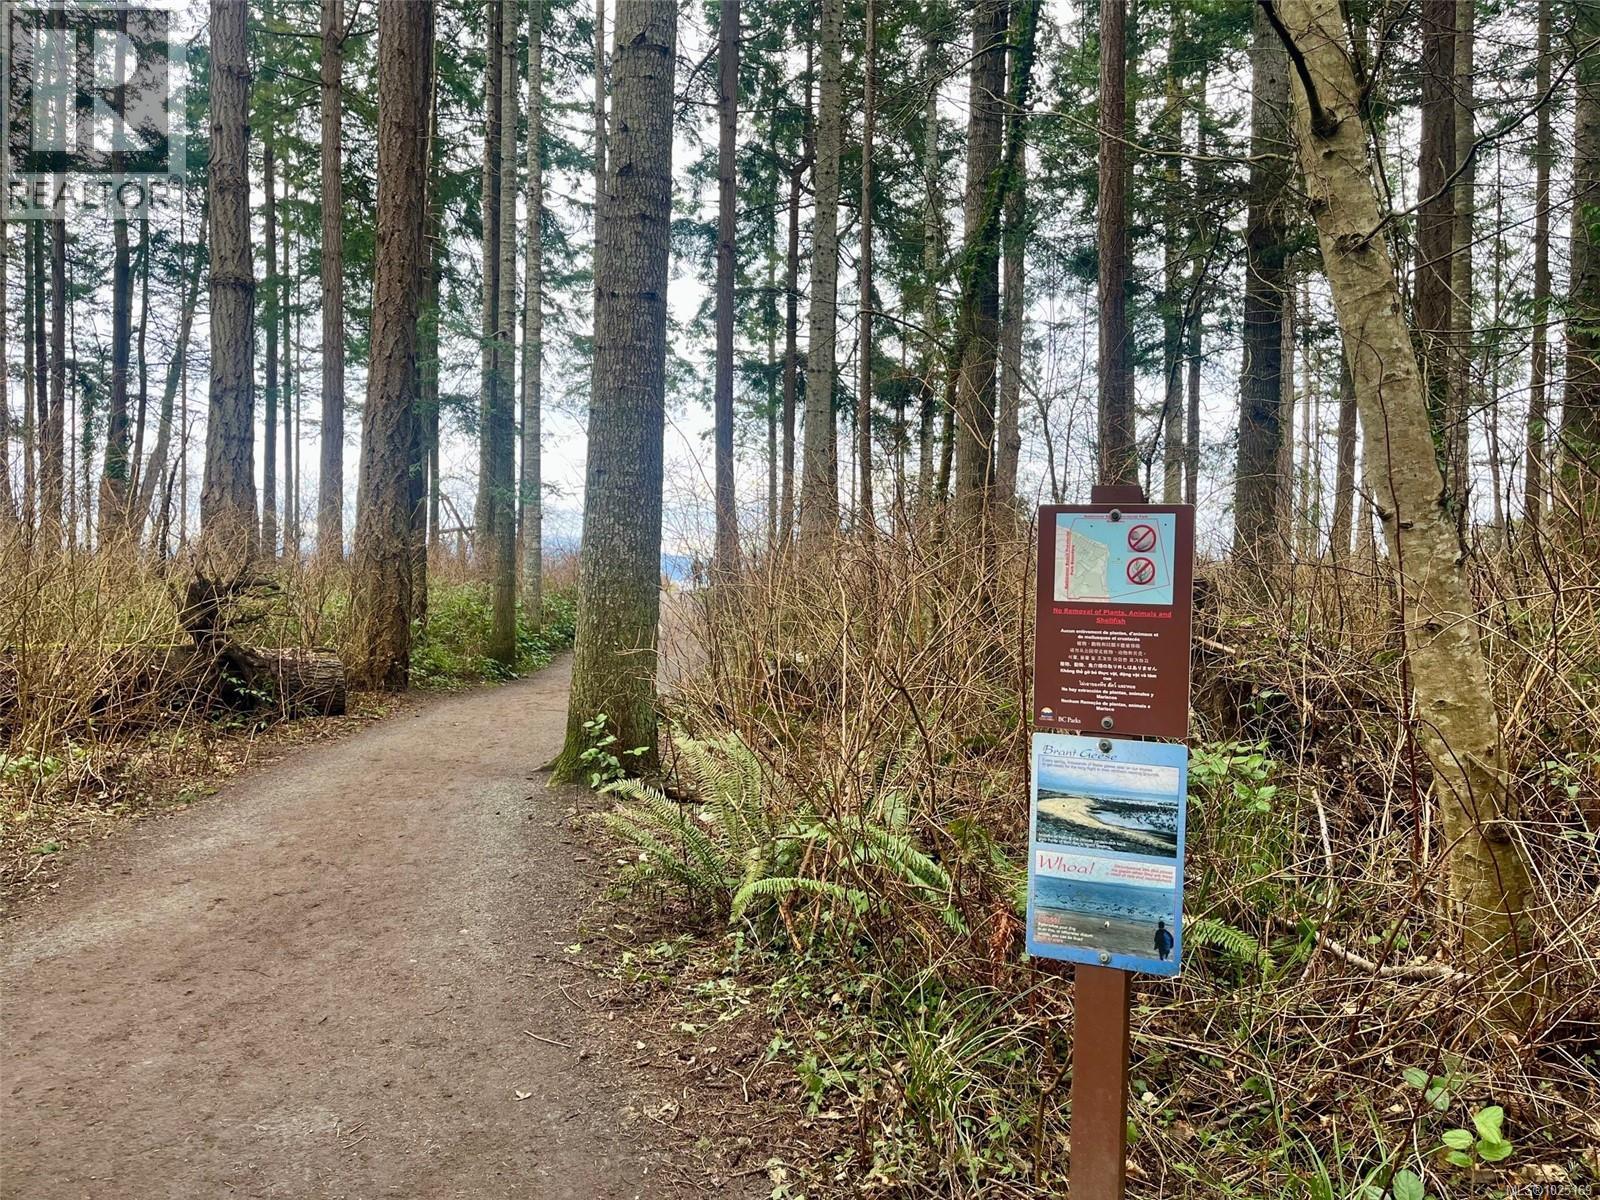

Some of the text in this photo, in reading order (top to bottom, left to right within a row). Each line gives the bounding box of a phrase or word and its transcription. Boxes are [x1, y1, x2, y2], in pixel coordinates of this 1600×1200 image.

[1129, 610, 1156, 618] Animals
[1096, 617, 1126, 625] Shellfish
[1057, 715, 1067, 723] BC
[1067, 715, 1082, 724] Parks
[1042, 744, 1118, 760] Brant Geese
[1039, 854, 1096, 875] Whoa!
